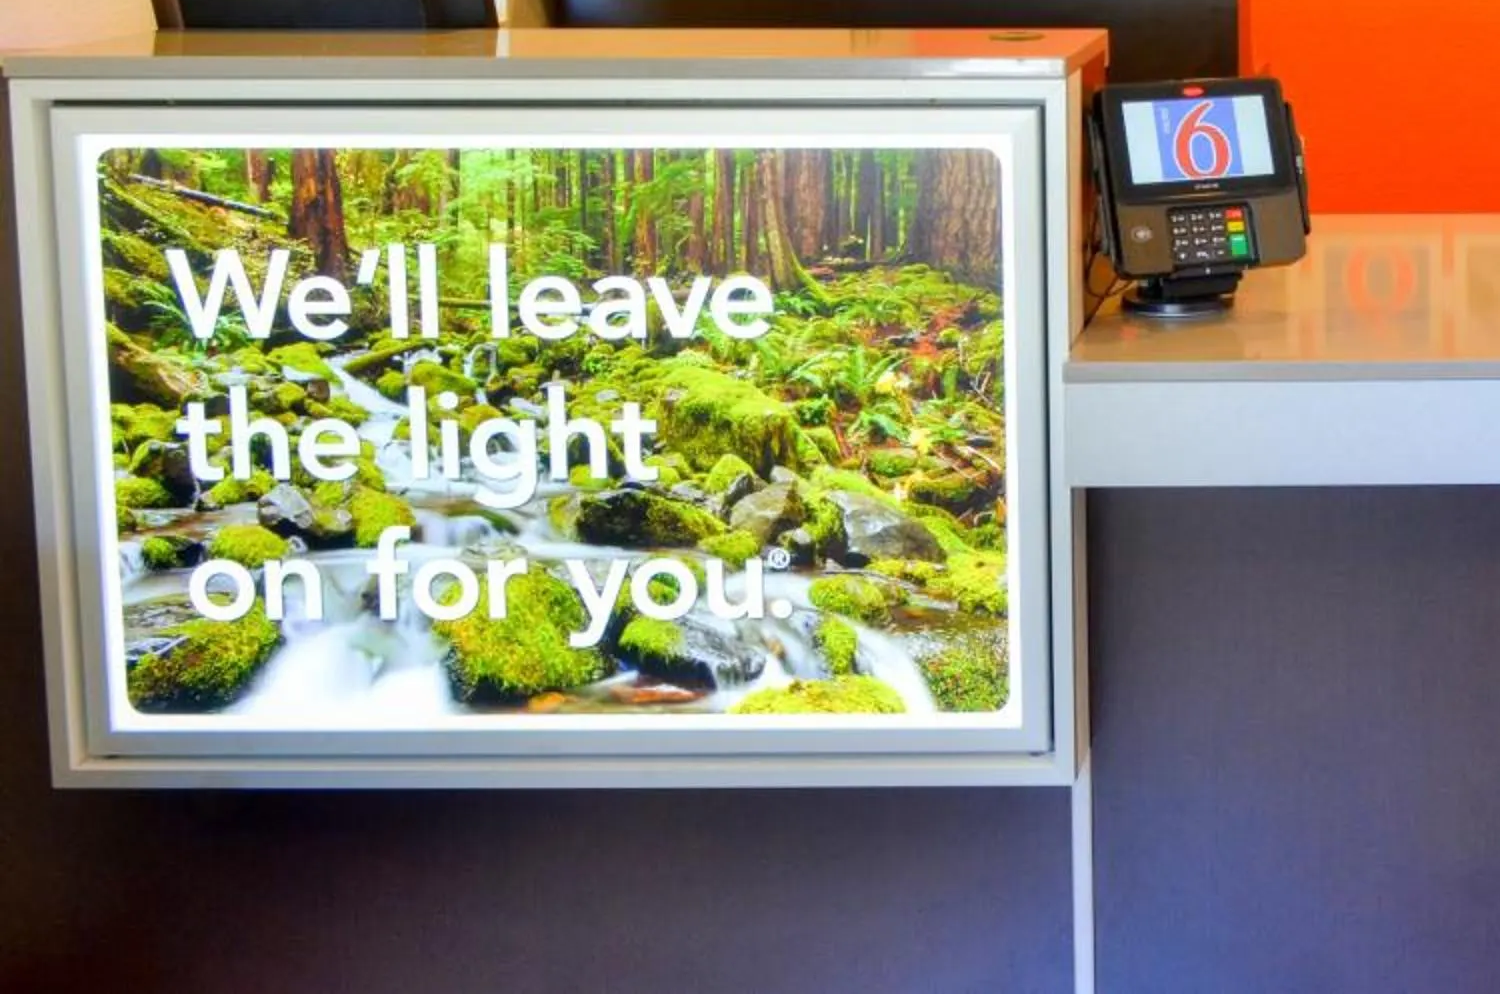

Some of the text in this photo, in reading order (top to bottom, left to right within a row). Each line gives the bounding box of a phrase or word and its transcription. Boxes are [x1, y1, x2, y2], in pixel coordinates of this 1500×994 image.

[1173, 99, 1232, 180] 6
[489, 243, 775, 340] leave
[176, 384, 659, 509] the light
[187, 558, 324, 623] on
[366, 525, 528, 623] for
